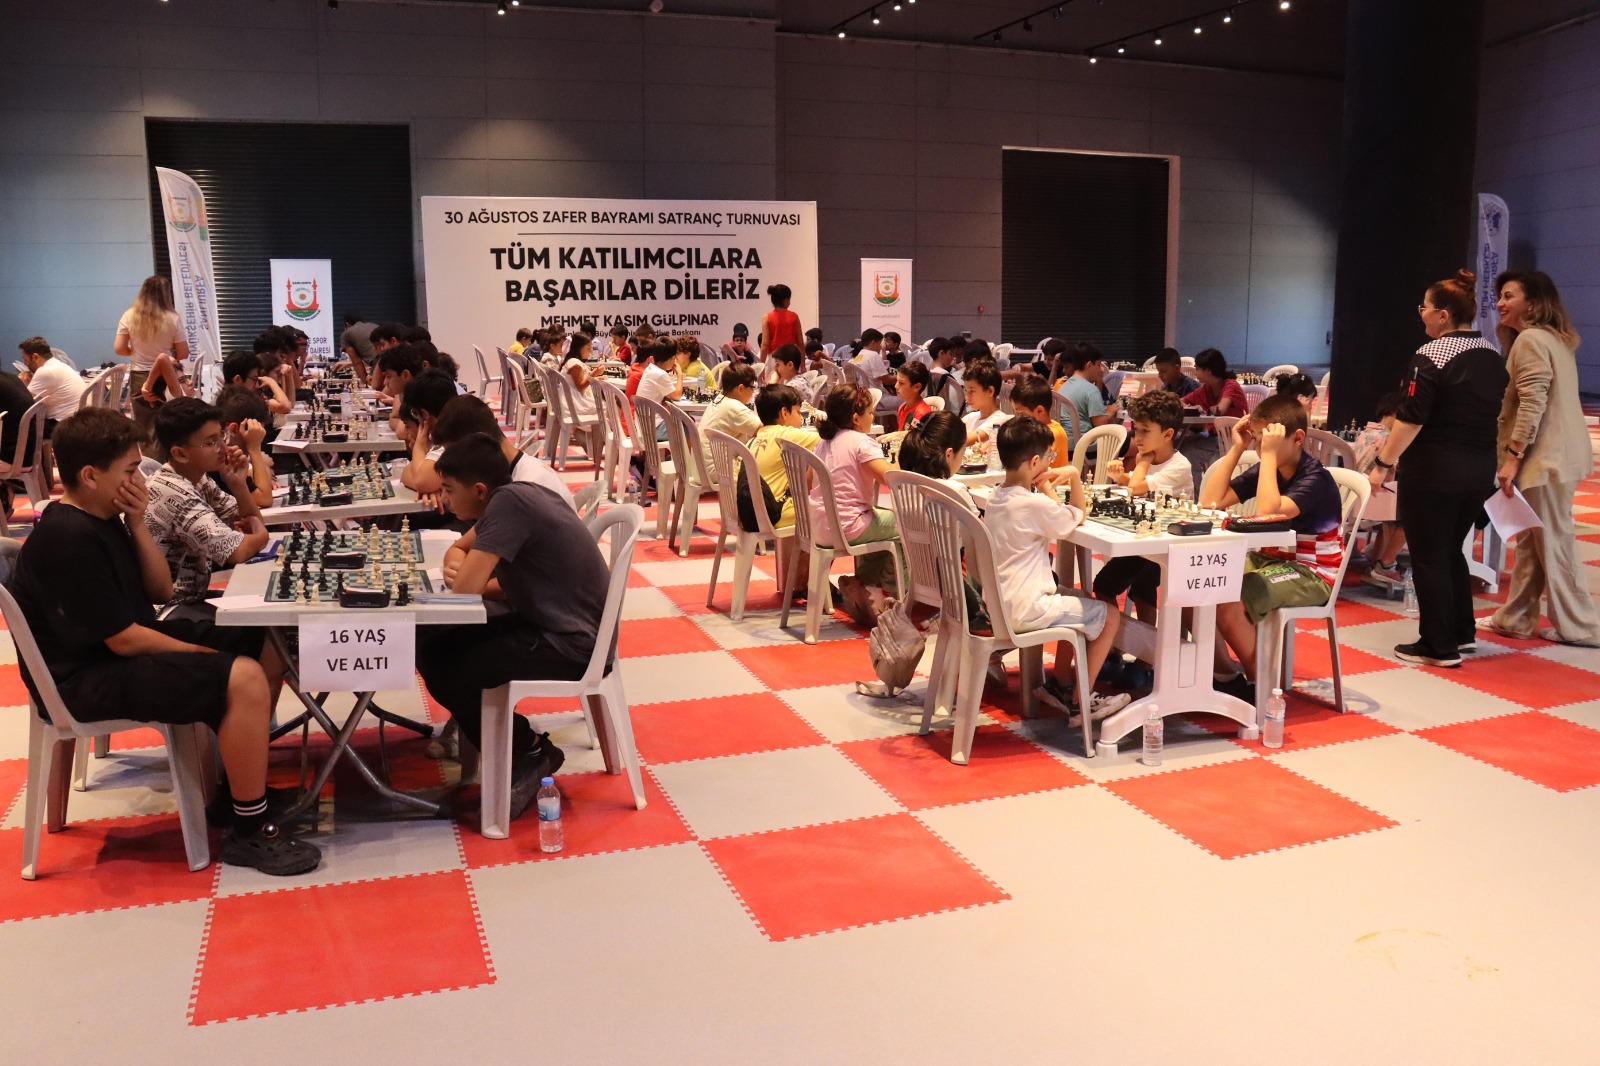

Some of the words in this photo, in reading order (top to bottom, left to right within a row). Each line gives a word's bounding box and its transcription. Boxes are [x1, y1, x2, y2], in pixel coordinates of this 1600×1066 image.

[444, 211, 463, 224] 30
[468, 208, 539, 224] AĞUSTOS
[543, 210, 587, 224] ZAFER
[591, 211, 654, 224] BAYRAMI
[658, 212, 722, 227] SATRANÇ
[726, 212, 801, 226] TURNUVASI
[490, 242, 551, 270] TÜM
[558, 247, 763, 270] KATILIMCILARA
[505, 278, 658, 307] BAŞARILAR
[664, 273, 760, 300] DİLERİZ
[541, 314, 600, 328] MEHMET
[603, 314, 648, 328] KASIM
[1190, 555, 1203, 566] 12
[1206, 553, 1227, 566] YAŞ
[1187, 578, 1201, 590] VE
[1203, 576, 1227, 588] ALTI
[329, 630, 349, 643] 16
[354, 628, 386, 645] YAŞ
[326, 658, 348, 671] VE
[353, 657, 388, 671] ALTI
